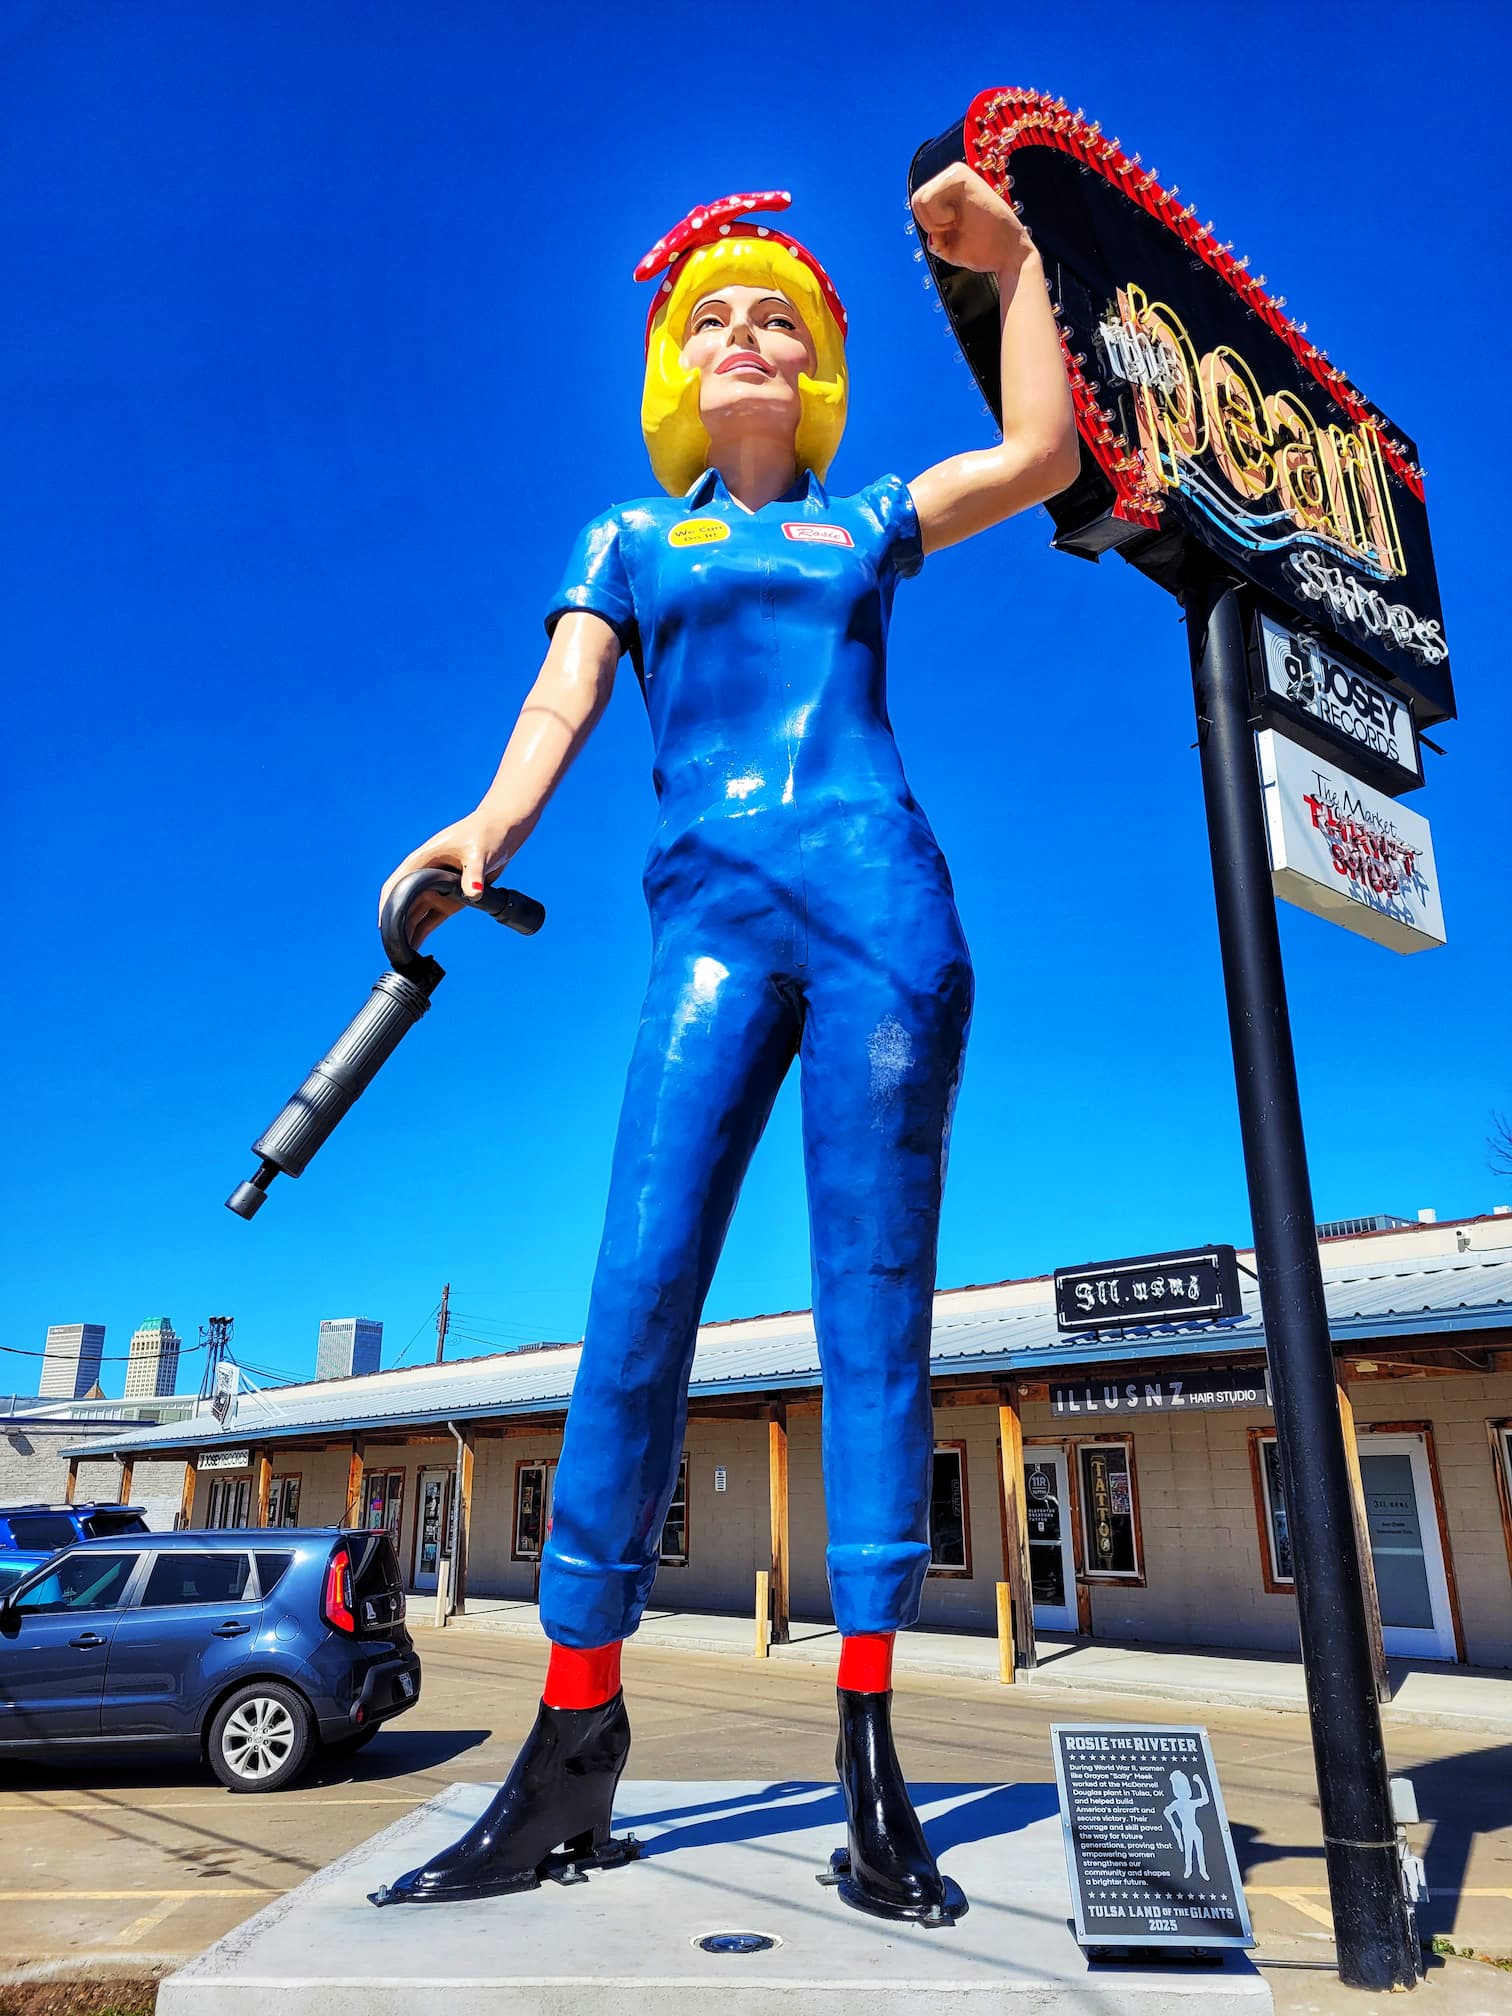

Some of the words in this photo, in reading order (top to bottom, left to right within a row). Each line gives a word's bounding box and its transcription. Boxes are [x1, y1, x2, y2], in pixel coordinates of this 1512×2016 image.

[796, 528, 840, 540] Rosie
[1316, 656, 1398, 736] JOSEY
[1320, 698, 1399, 760] RECORDS
[1312, 770, 1339, 806] The
[1343, 790, 1400, 838] Market
[1057, 1382, 1185, 1412] ILLUSNZ
[1190, 1392, 1214, 1404] HAIR
[1216, 1390, 1256, 1404] STUDIO
[1092, 1461, 1111, 1551] TATTOO
[1065, 1737, 1110, 1750] ROSIE
[1110, 1738, 1133, 1748] THE
[1133, 1737, 1198, 1752] RIVETER
[1088, 1906, 1126, 1918] TULSA
[1128, 1906, 1161, 1918] LAND
[1190, 1907, 1234, 1919] GIANTS
[1149, 1919, 1178, 1931] 2025
